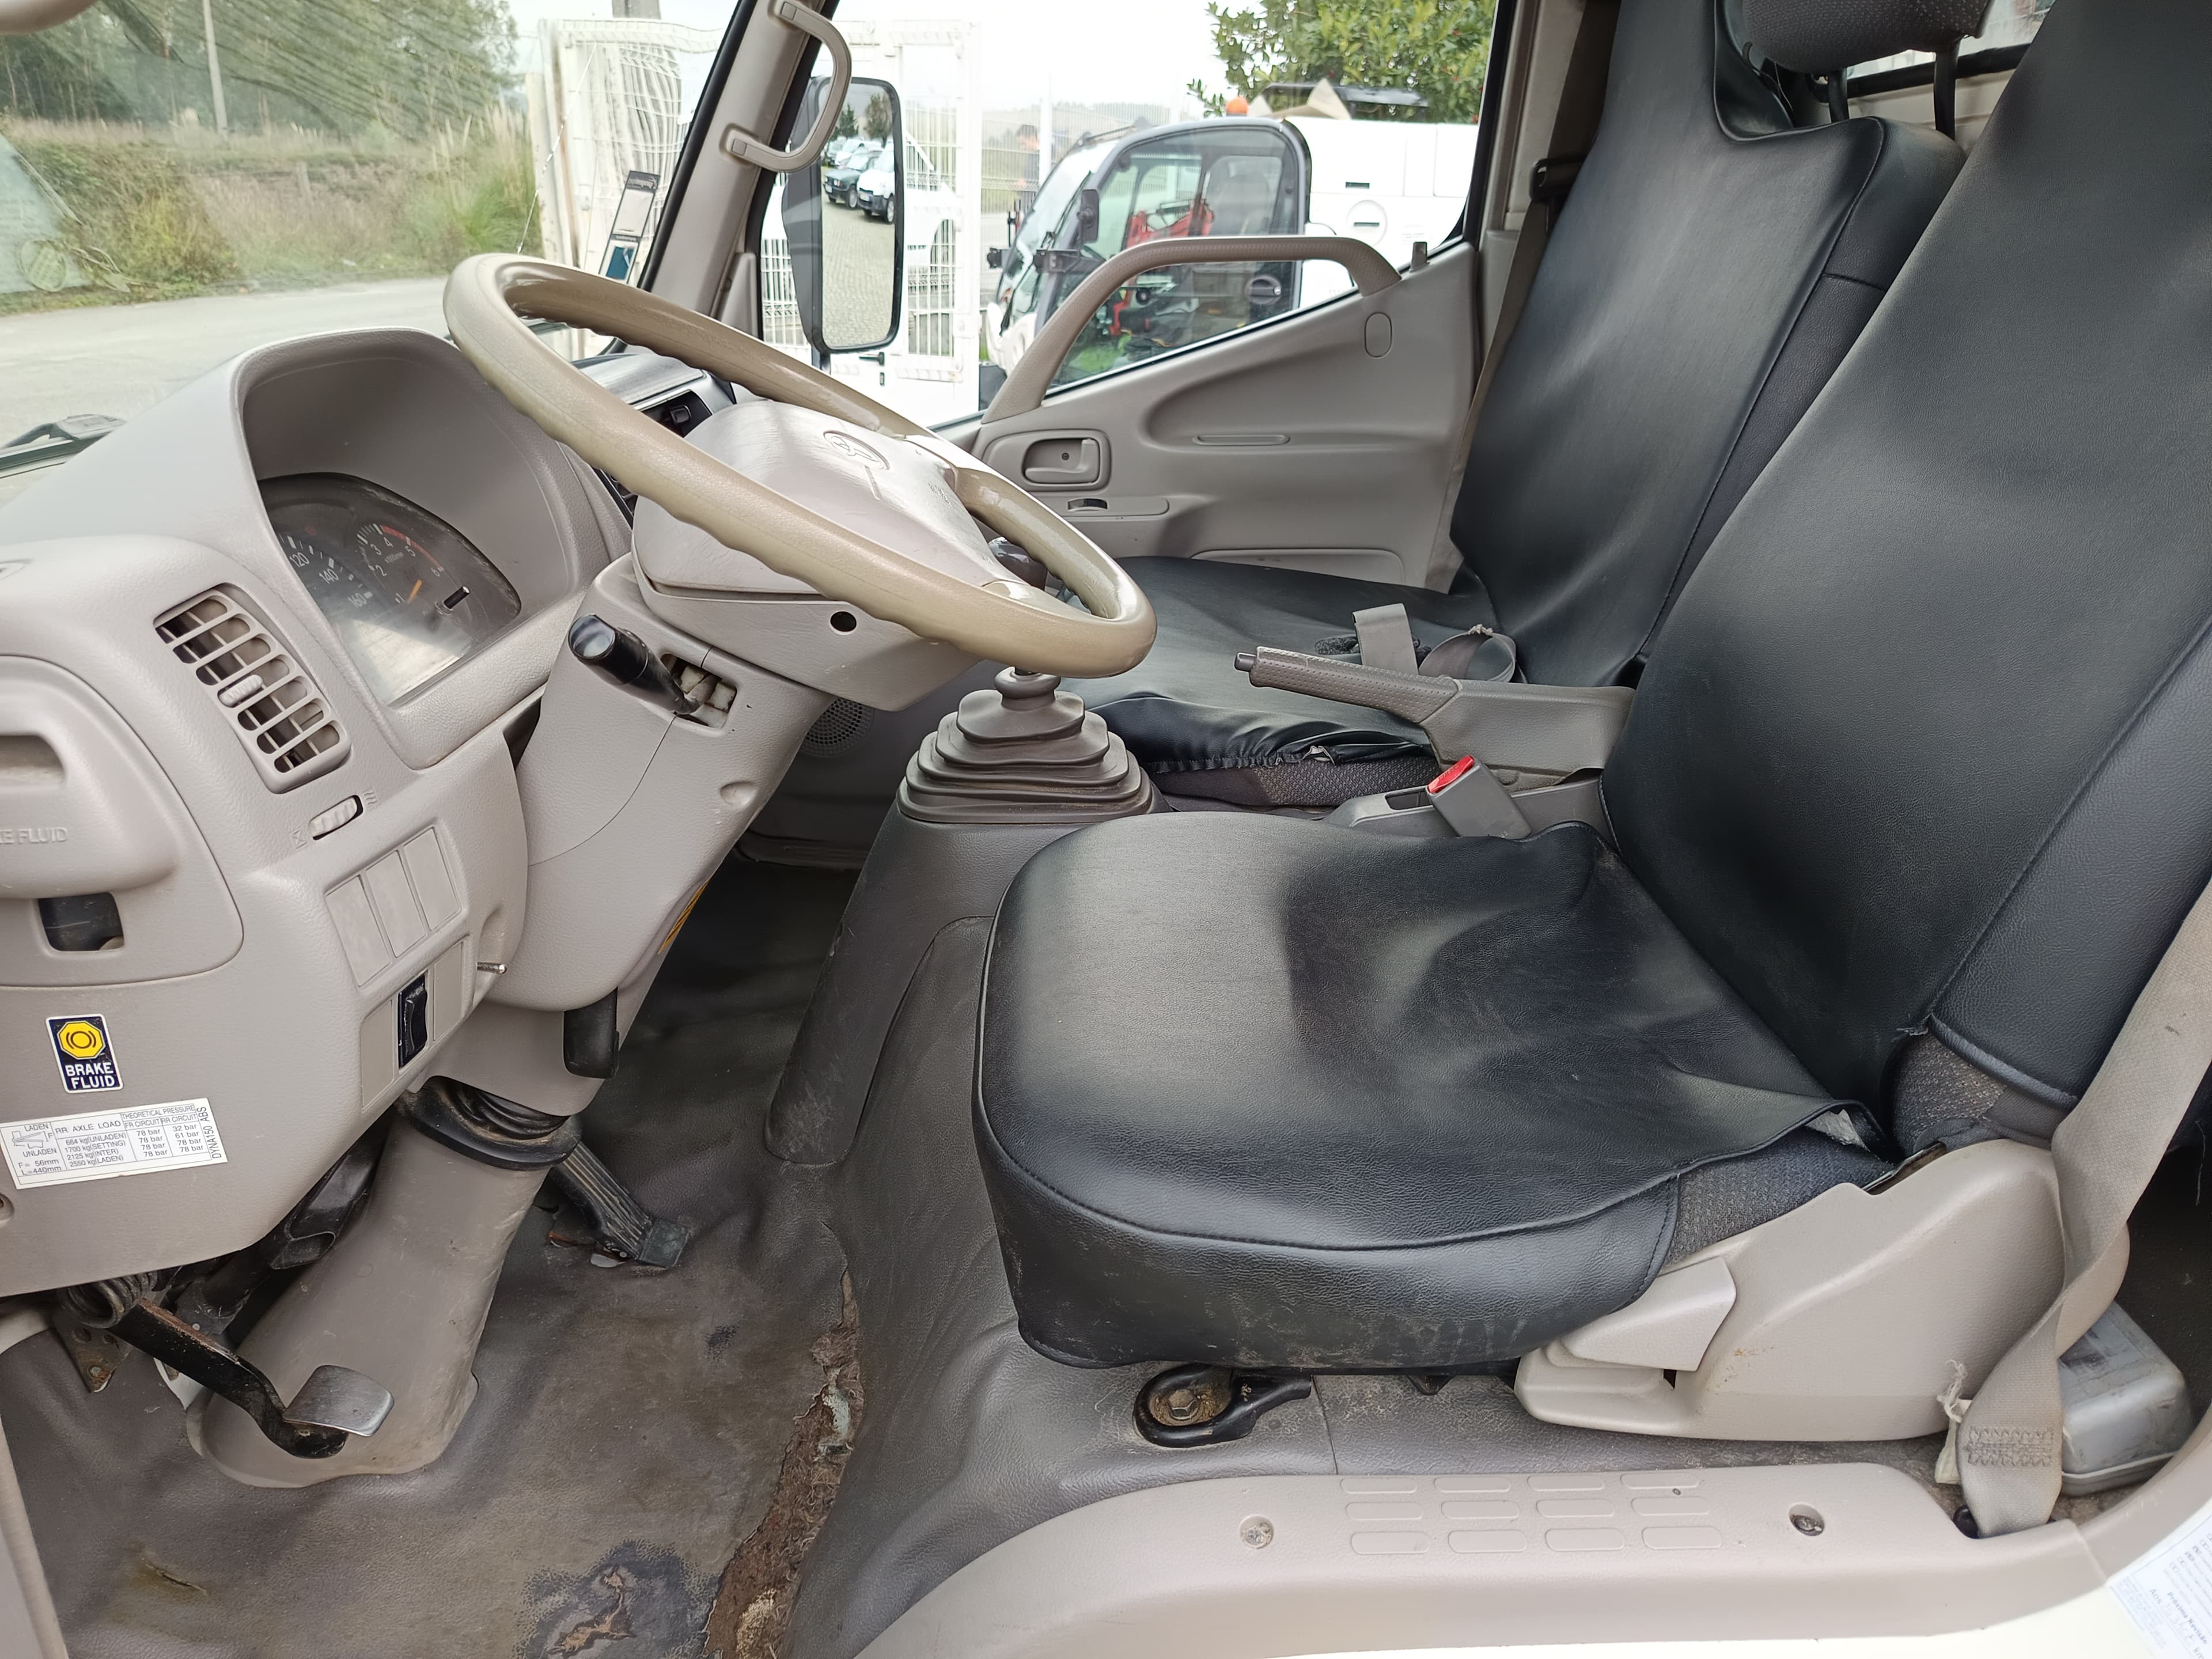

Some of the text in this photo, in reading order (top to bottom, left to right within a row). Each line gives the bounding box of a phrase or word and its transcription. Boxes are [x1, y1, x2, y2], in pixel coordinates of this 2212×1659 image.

[384, 537, 393, 547] 4
[370, 544, 382, 555] 3
[405, 546, 416, 556] 5
[289, 552, 309, 567] 120
[319, 568, 339, 584] 140
[376, 565, 387, 577] 2
[431, 567, 440, 577] 6
[347, 593, 367, 608] 160
[18, 827, 68, 844] FLUID
[65, 1062, 114, 1077] BRAKE
[71, 1075, 115, 1089] FLUID
[122, 1105, 196, 1120] THEORETICAL PRESSURE
[172, 1114, 198, 1123] CIRCUIT
[73, 1124, 94, 1132] AXLE
[98, 1120, 122, 1129] LOAD
[134, 1118, 161, 1127] CIRCUIT
[196, 1106, 222, 1159] DYNA150 ABS
[82, 1140, 126, 1152] kg(SETTING)
[22, 1148, 57, 1157] UNLADEN
[85, 1148, 119, 1158] kg(INTER)
[86, 1155, 124, 1166] kg(LADEN)
